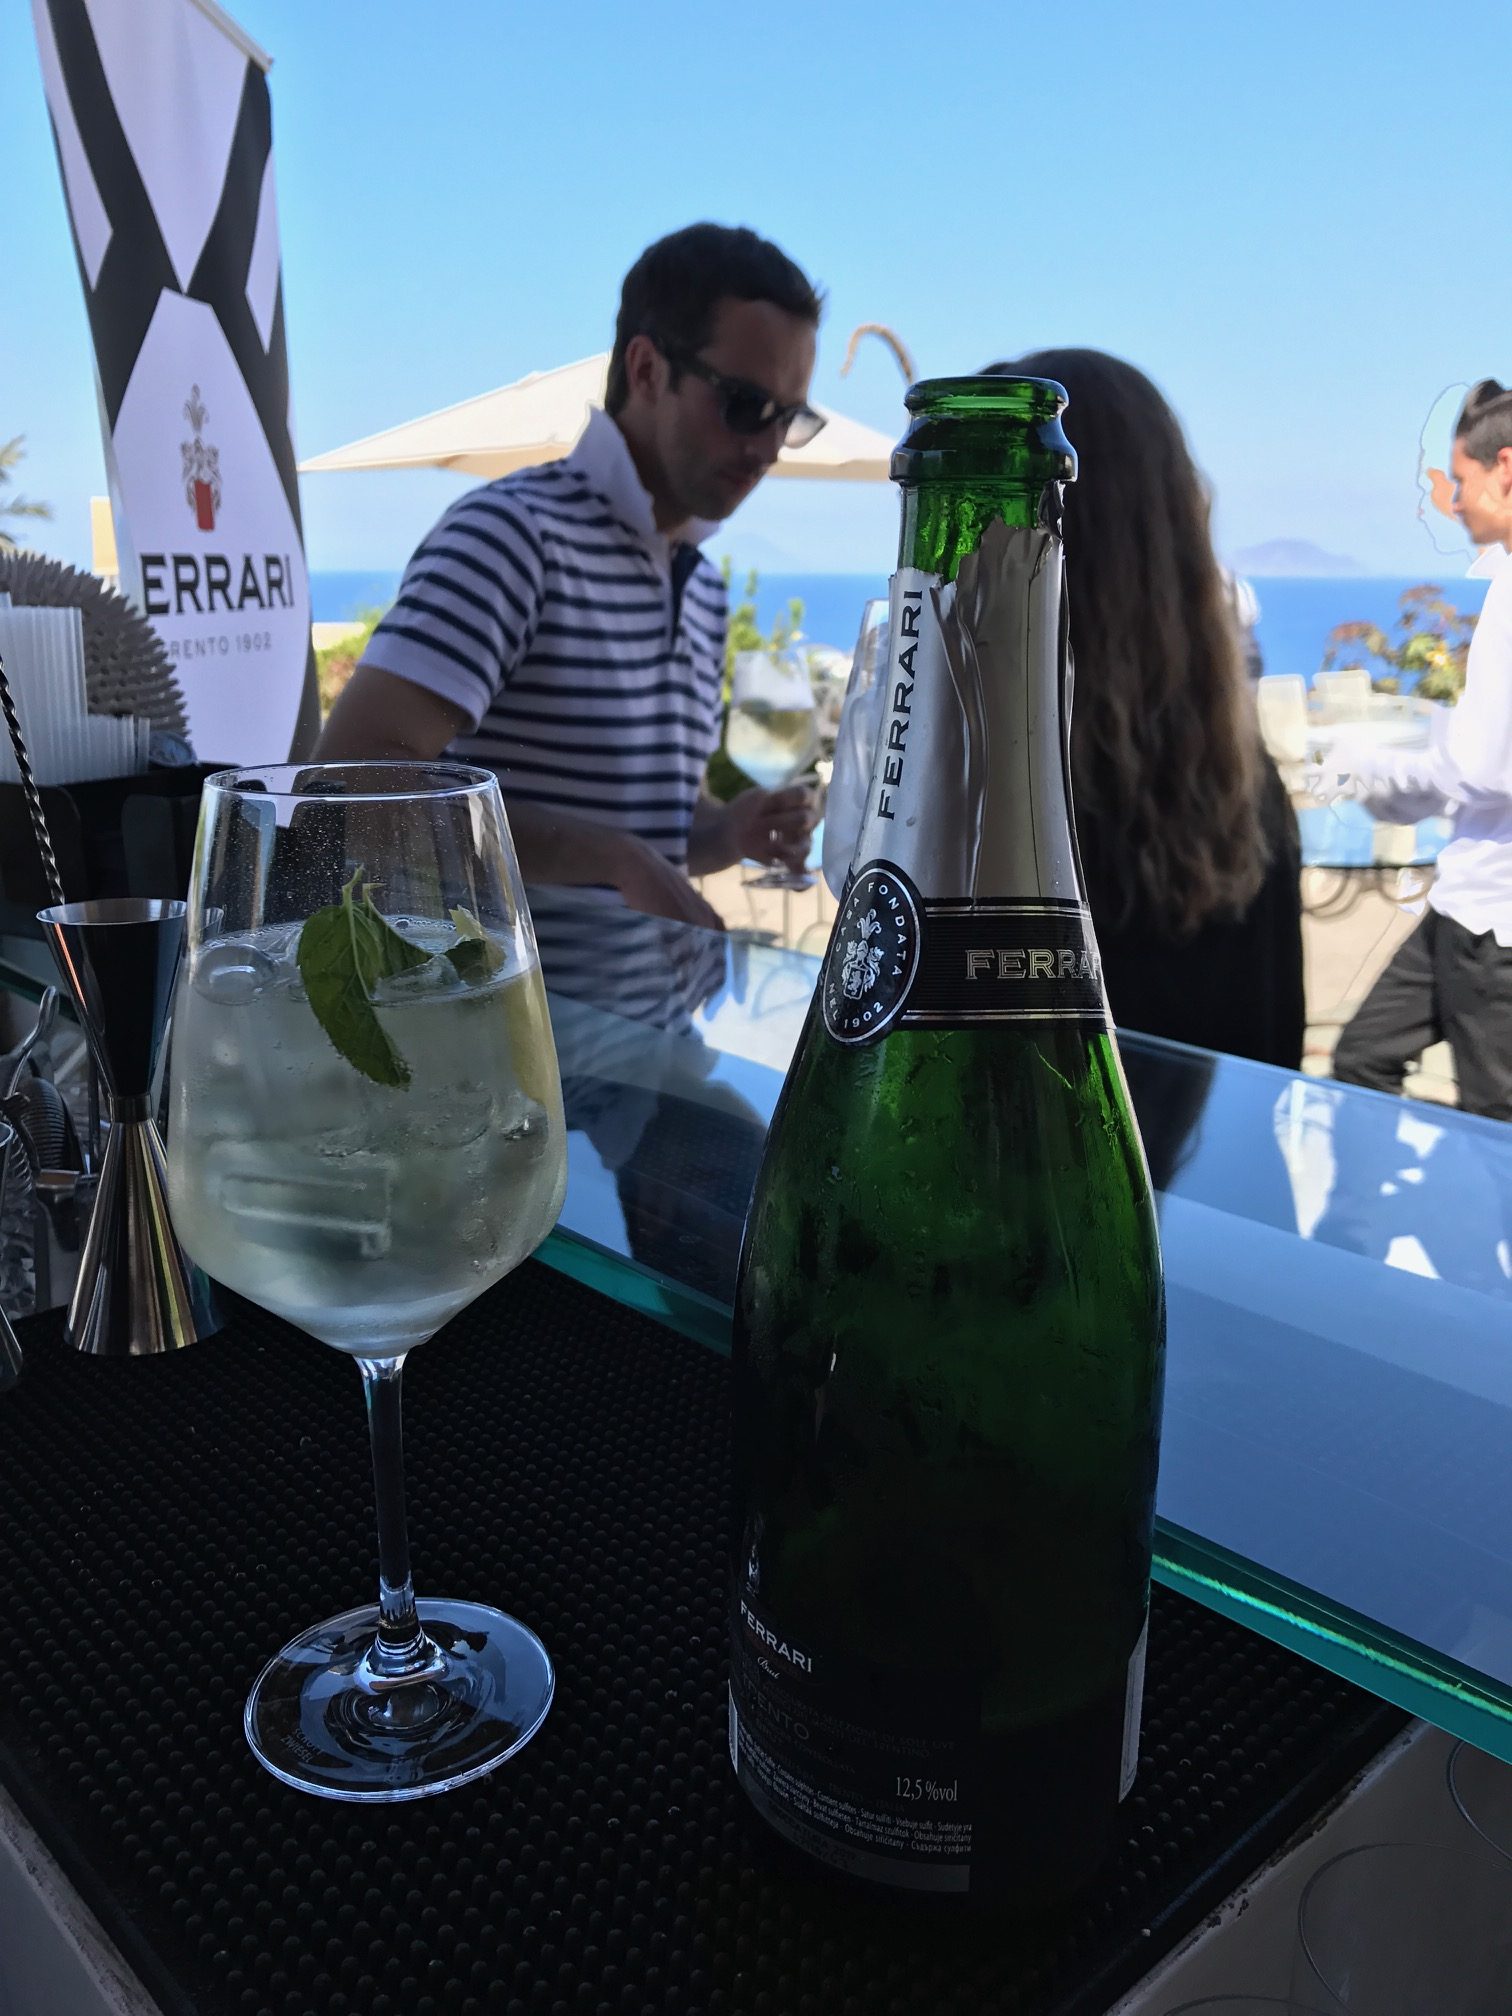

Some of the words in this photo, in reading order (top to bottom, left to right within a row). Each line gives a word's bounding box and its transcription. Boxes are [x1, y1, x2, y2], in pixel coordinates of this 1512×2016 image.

[139, 552, 295, 615] ERRARI
[169, 636, 230, 660] RENTO
[234, 632, 273, 654] 1902
[877, 590, 923, 820] FERRARI
[867, 882, 907, 976] FONDATA
[828, 983, 840, 1021] NEL
[844, 1001, 884, 1029] 1902
[740, 1599, 813, 1673] FERRARI
[757, 1656, 781, 1679] Brut
[280, 1734, 315, 1764] ZWIESEL
[896, 1776, 923, 1801] 12,5
[925, 1779, 959, 1802] %vol
